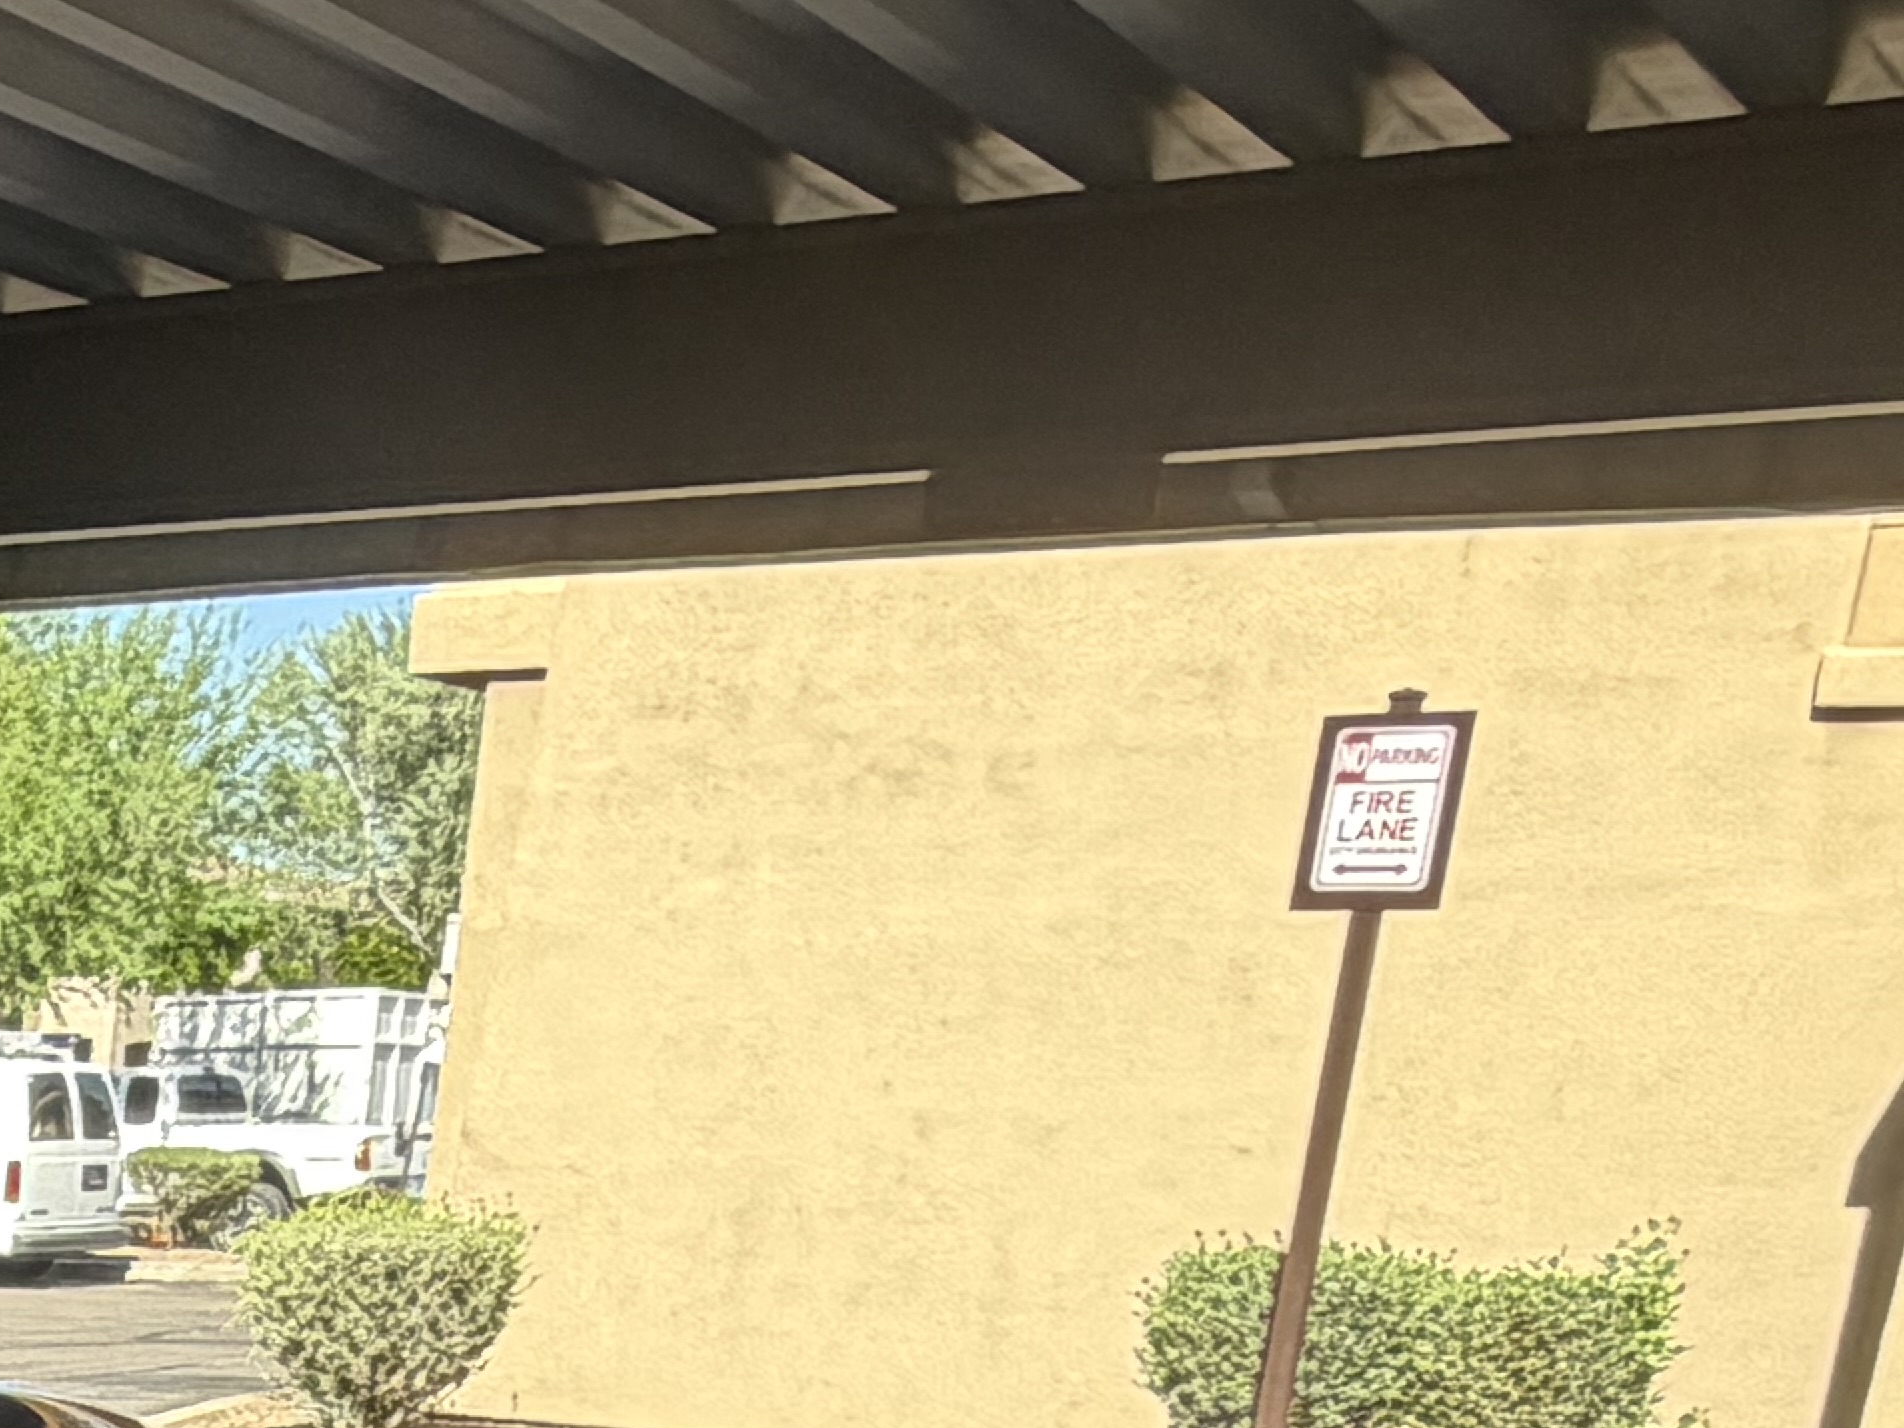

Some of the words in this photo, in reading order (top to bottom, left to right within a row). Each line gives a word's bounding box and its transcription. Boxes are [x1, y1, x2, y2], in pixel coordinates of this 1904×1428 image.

[1340, 741, 1370, 773] NO
[1370, 747, 1439, 764] PARKING
[1350, 790, 1416, 813] FIRE
[1337, 817, 1419, 841] LANE
